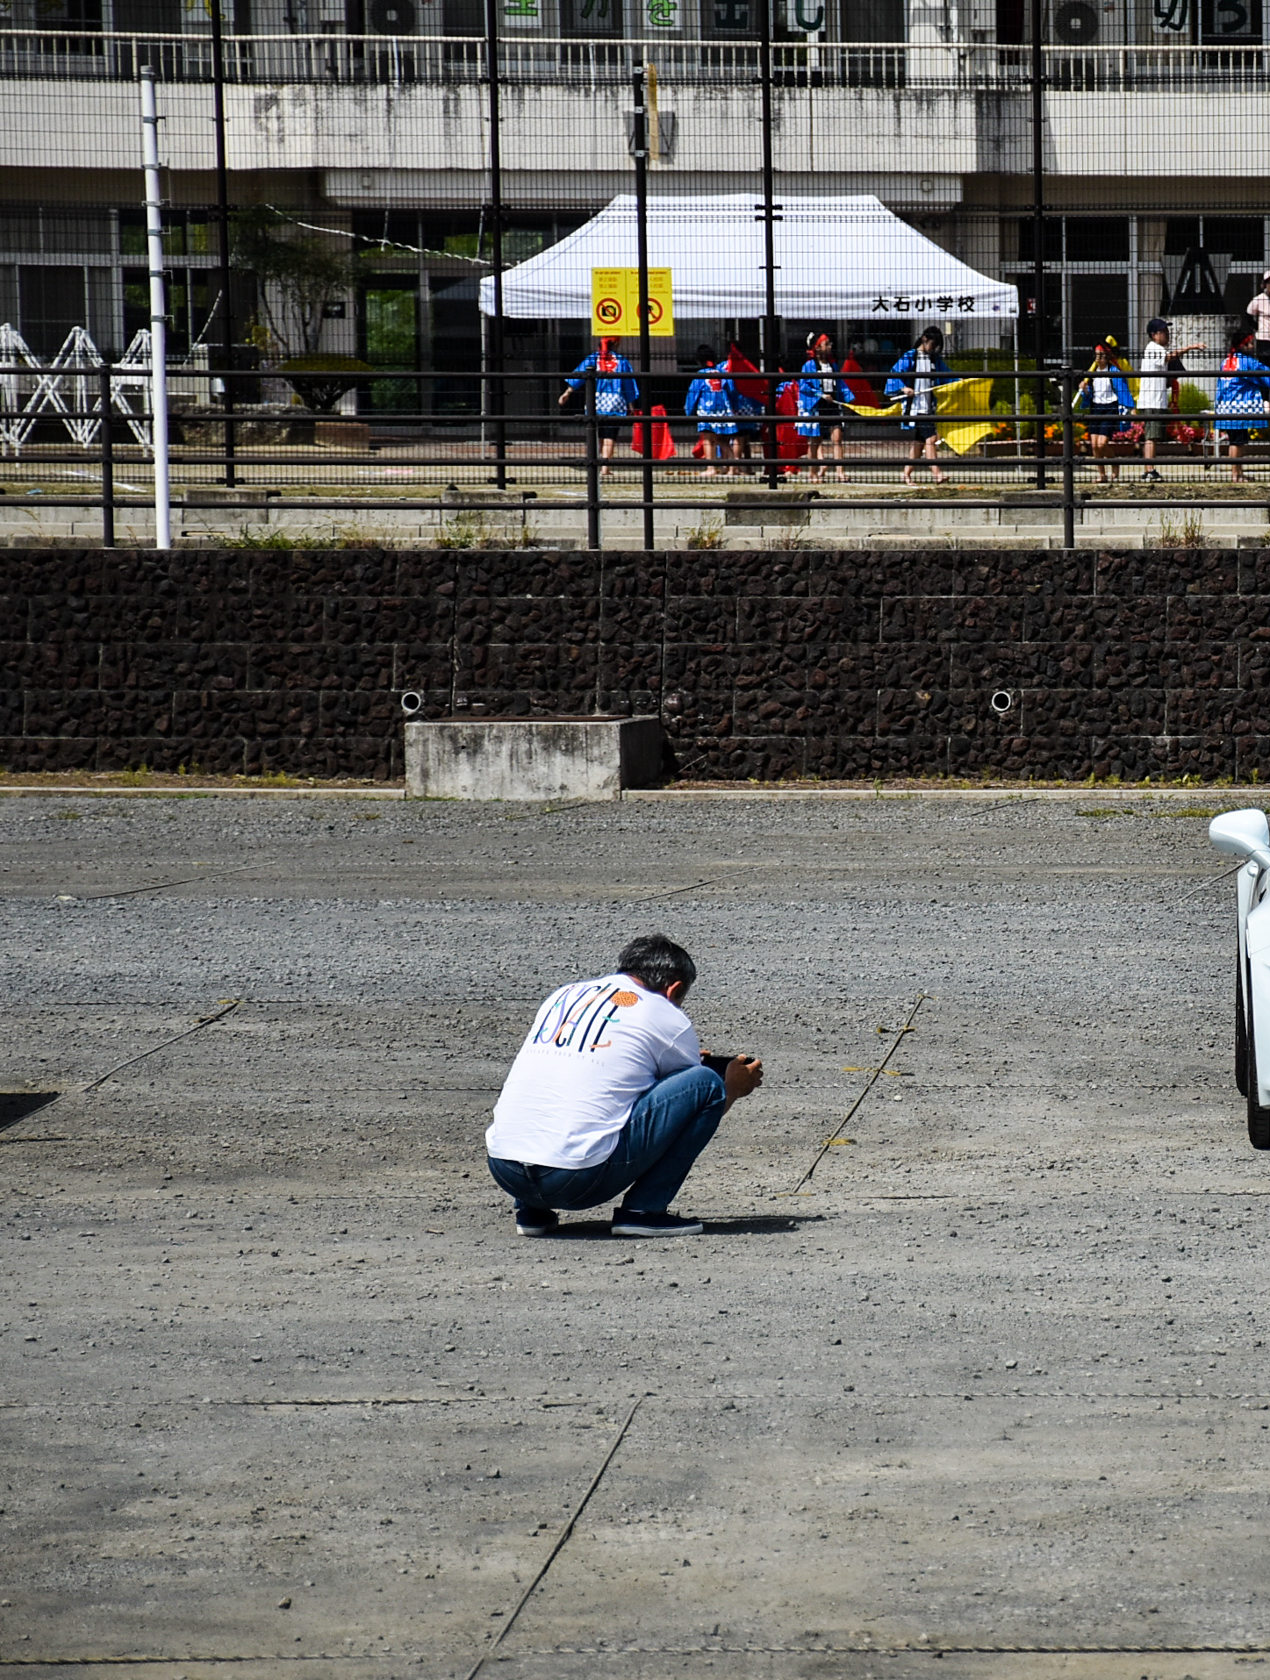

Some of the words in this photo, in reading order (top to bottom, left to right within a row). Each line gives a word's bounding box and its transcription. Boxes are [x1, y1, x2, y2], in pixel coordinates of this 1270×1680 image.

[872, 295, 975, 312] 大石小学校
